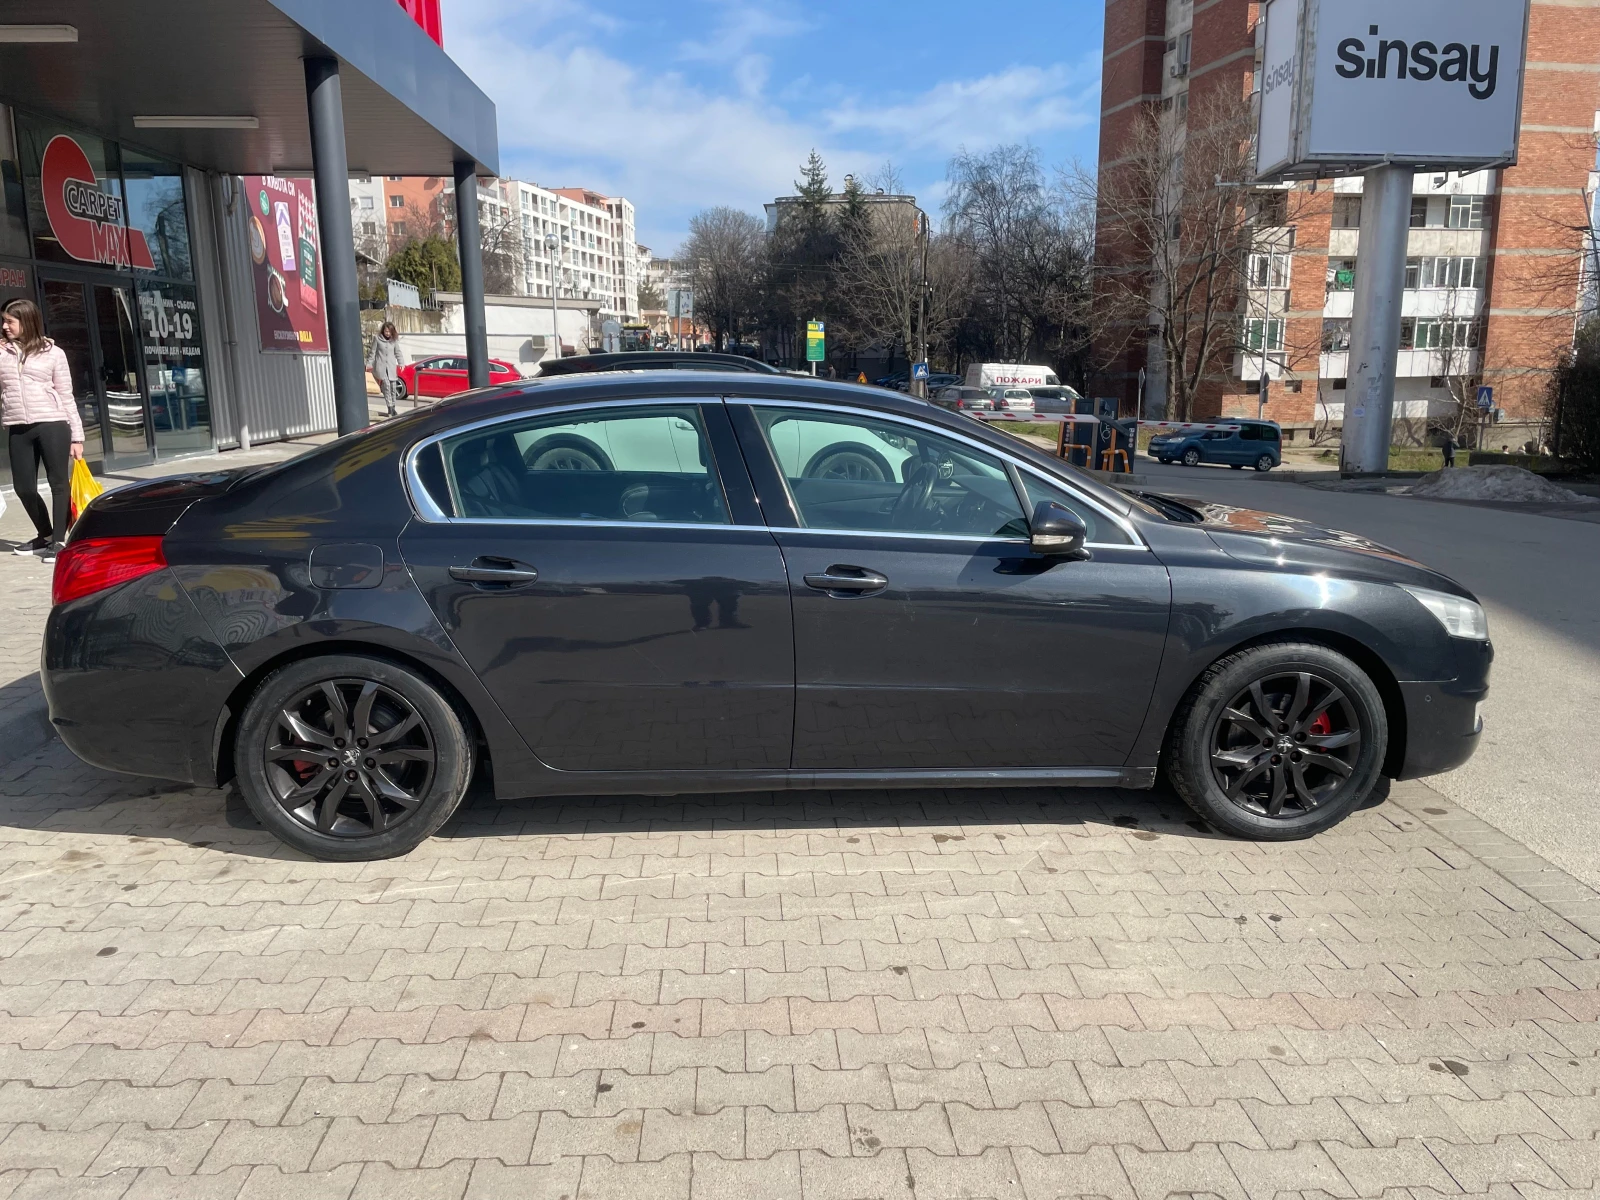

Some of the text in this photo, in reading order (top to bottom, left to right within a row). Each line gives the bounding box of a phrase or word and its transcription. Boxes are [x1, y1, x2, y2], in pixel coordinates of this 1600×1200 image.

[1265, 55, 1295, 95] sinsay
[1335, 25, 1500, 100] sinsay
[287, 181, 296, 197] СИ
[66, 185, 122, 220] CARPET
[91, 221, 131, 267] MAX
[0, 267, 26, 288] РАН
[176, 300, 196, 311] СЪБОТА
[147, 311, 193, 340] 10-19
[169, 346, 179, 357] ДЕН
[182, 346, 201, 357] НЕДЕЛЯ
[996, 376, 1042, 385] ПОЖАРИ
